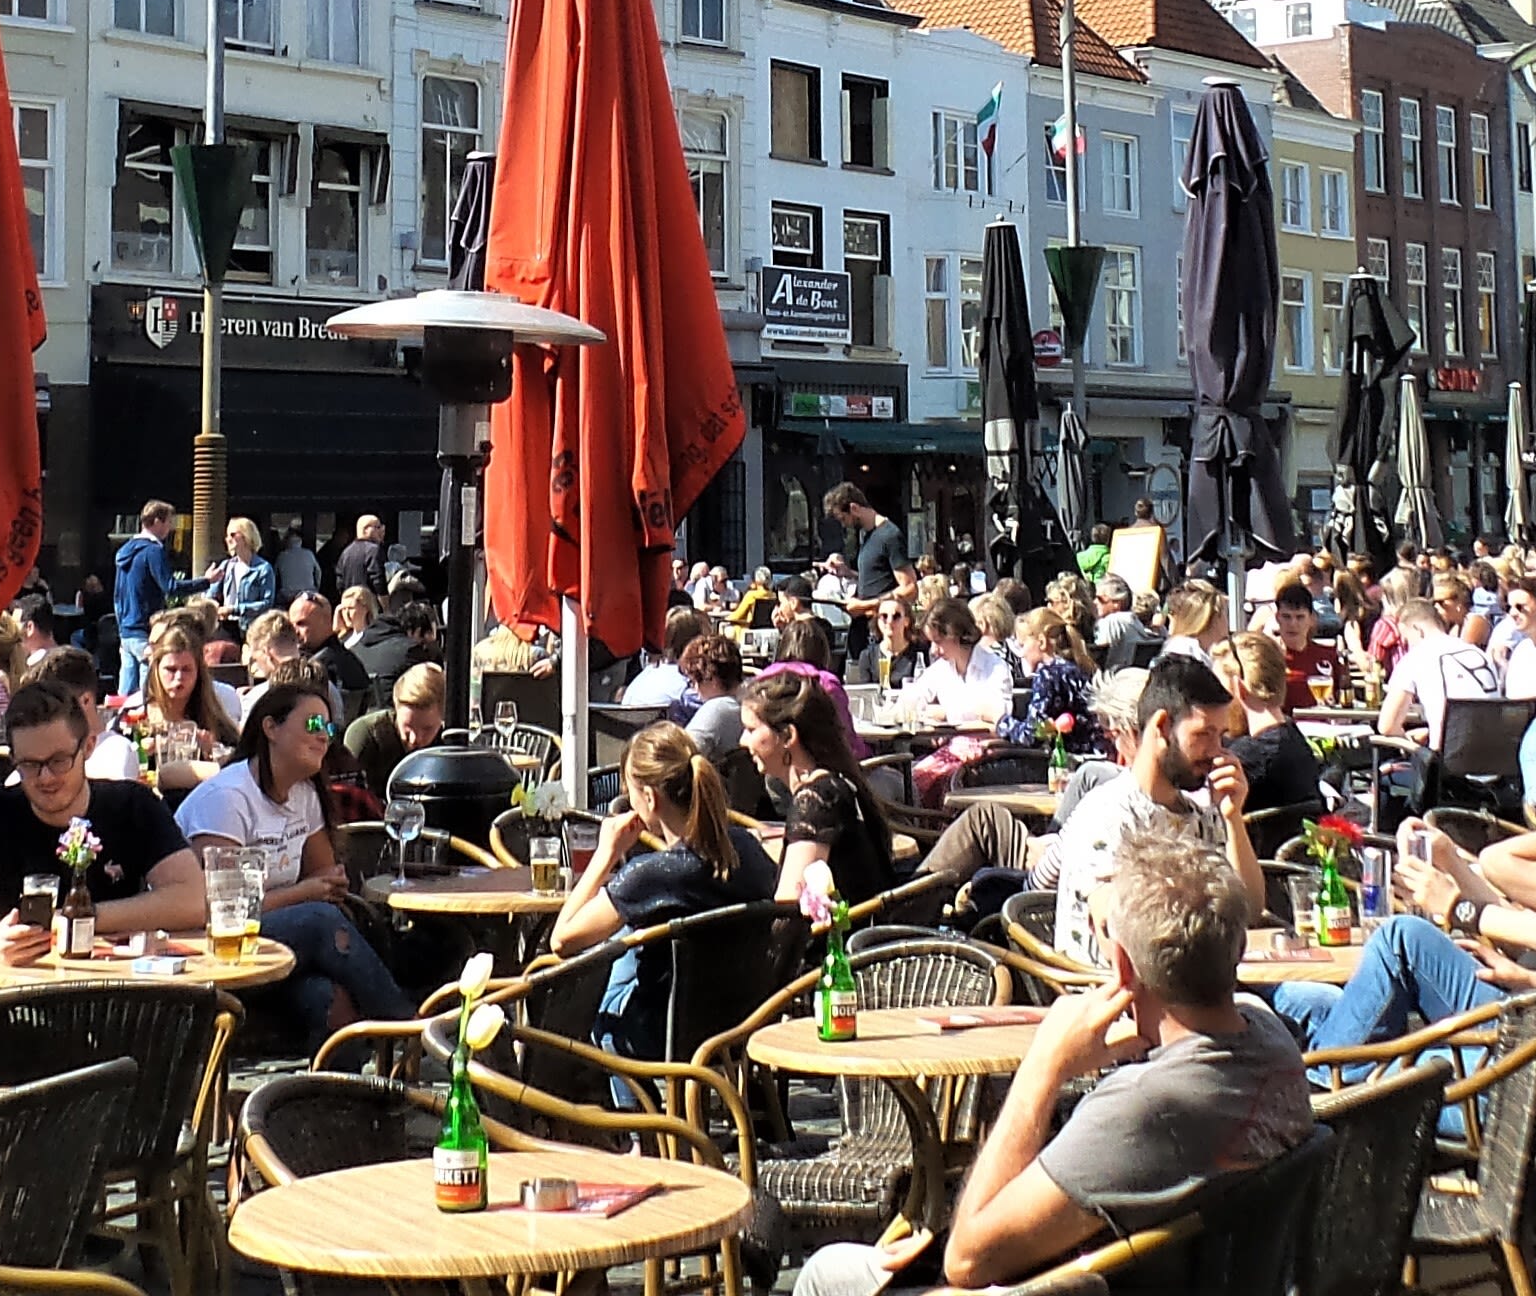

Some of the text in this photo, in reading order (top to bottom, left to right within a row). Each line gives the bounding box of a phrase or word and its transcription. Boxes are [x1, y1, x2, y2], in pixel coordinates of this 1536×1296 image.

[771, 273, 839, 306] Alexander
[191, 311, 258, 336] Heren
[262, 317, 294, 337] van
